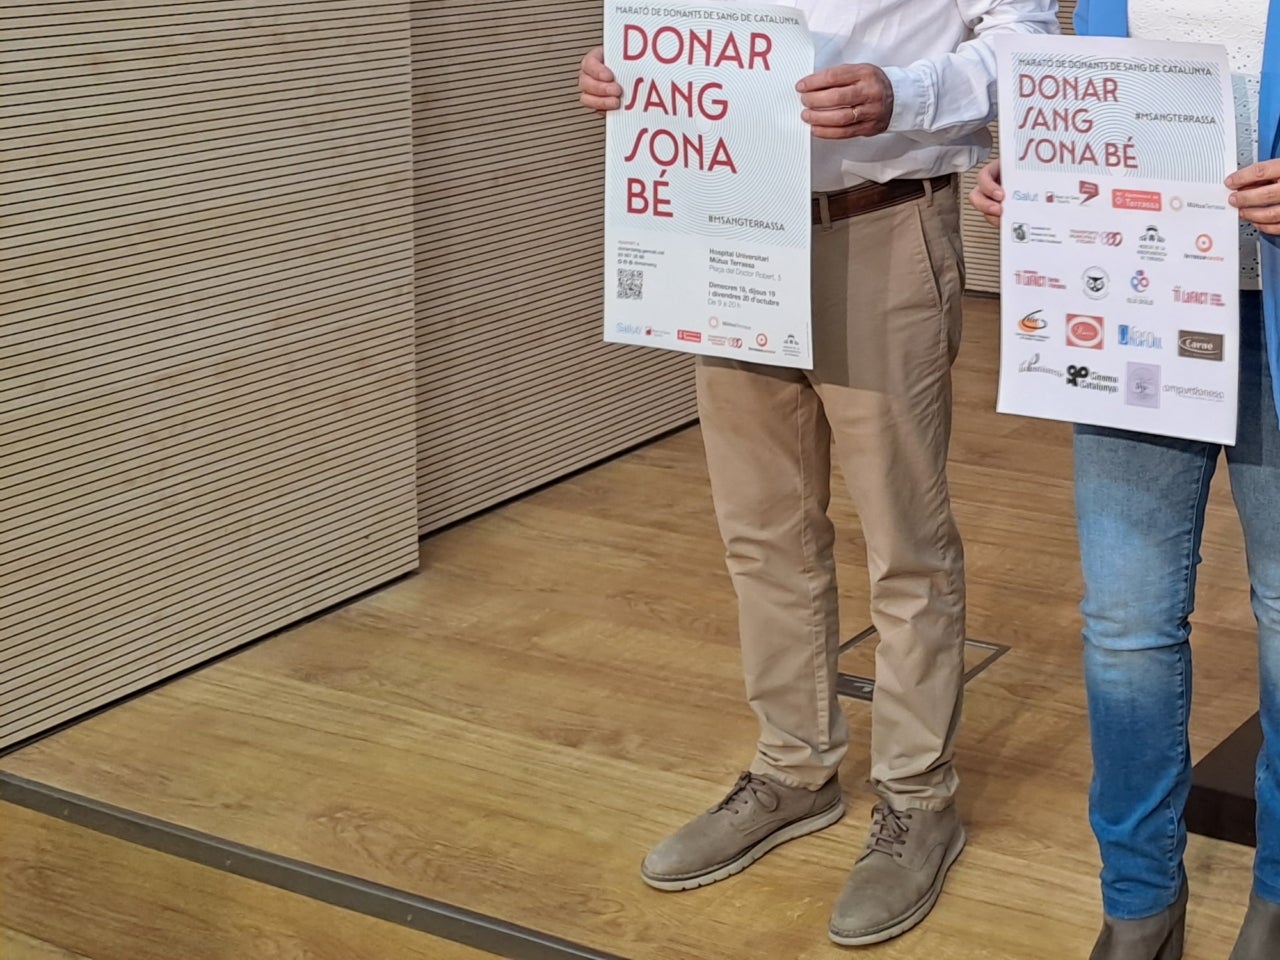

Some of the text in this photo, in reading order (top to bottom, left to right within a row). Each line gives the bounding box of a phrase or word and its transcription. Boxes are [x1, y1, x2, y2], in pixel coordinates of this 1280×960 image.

[615, 5, 800, 25] MARATÓ DE DONANTS DE SANG DE CATALUNYA
[622, 23, 773, 71] DONAR
[1018, 58, 1212, 77] MARATÓ DE DONANTS DE SANG DE CATALUNYA
[624, 77, 729, 122] SANG
[1018, 73, 1119, 102] DONAR
[1018, 106, 1094, 134] SANG
[1135, 112, 1217, 125] #MSANGTERRASSA
[624, 127, 738, 175] SONA
[1018, 136, 1139, 169] SONA BÉ
[626, 169, 674, 218] BÉ
[708, 214, 786, 232] #MSANGTERRASSA
[709, 248, 734, 258] Hospital
